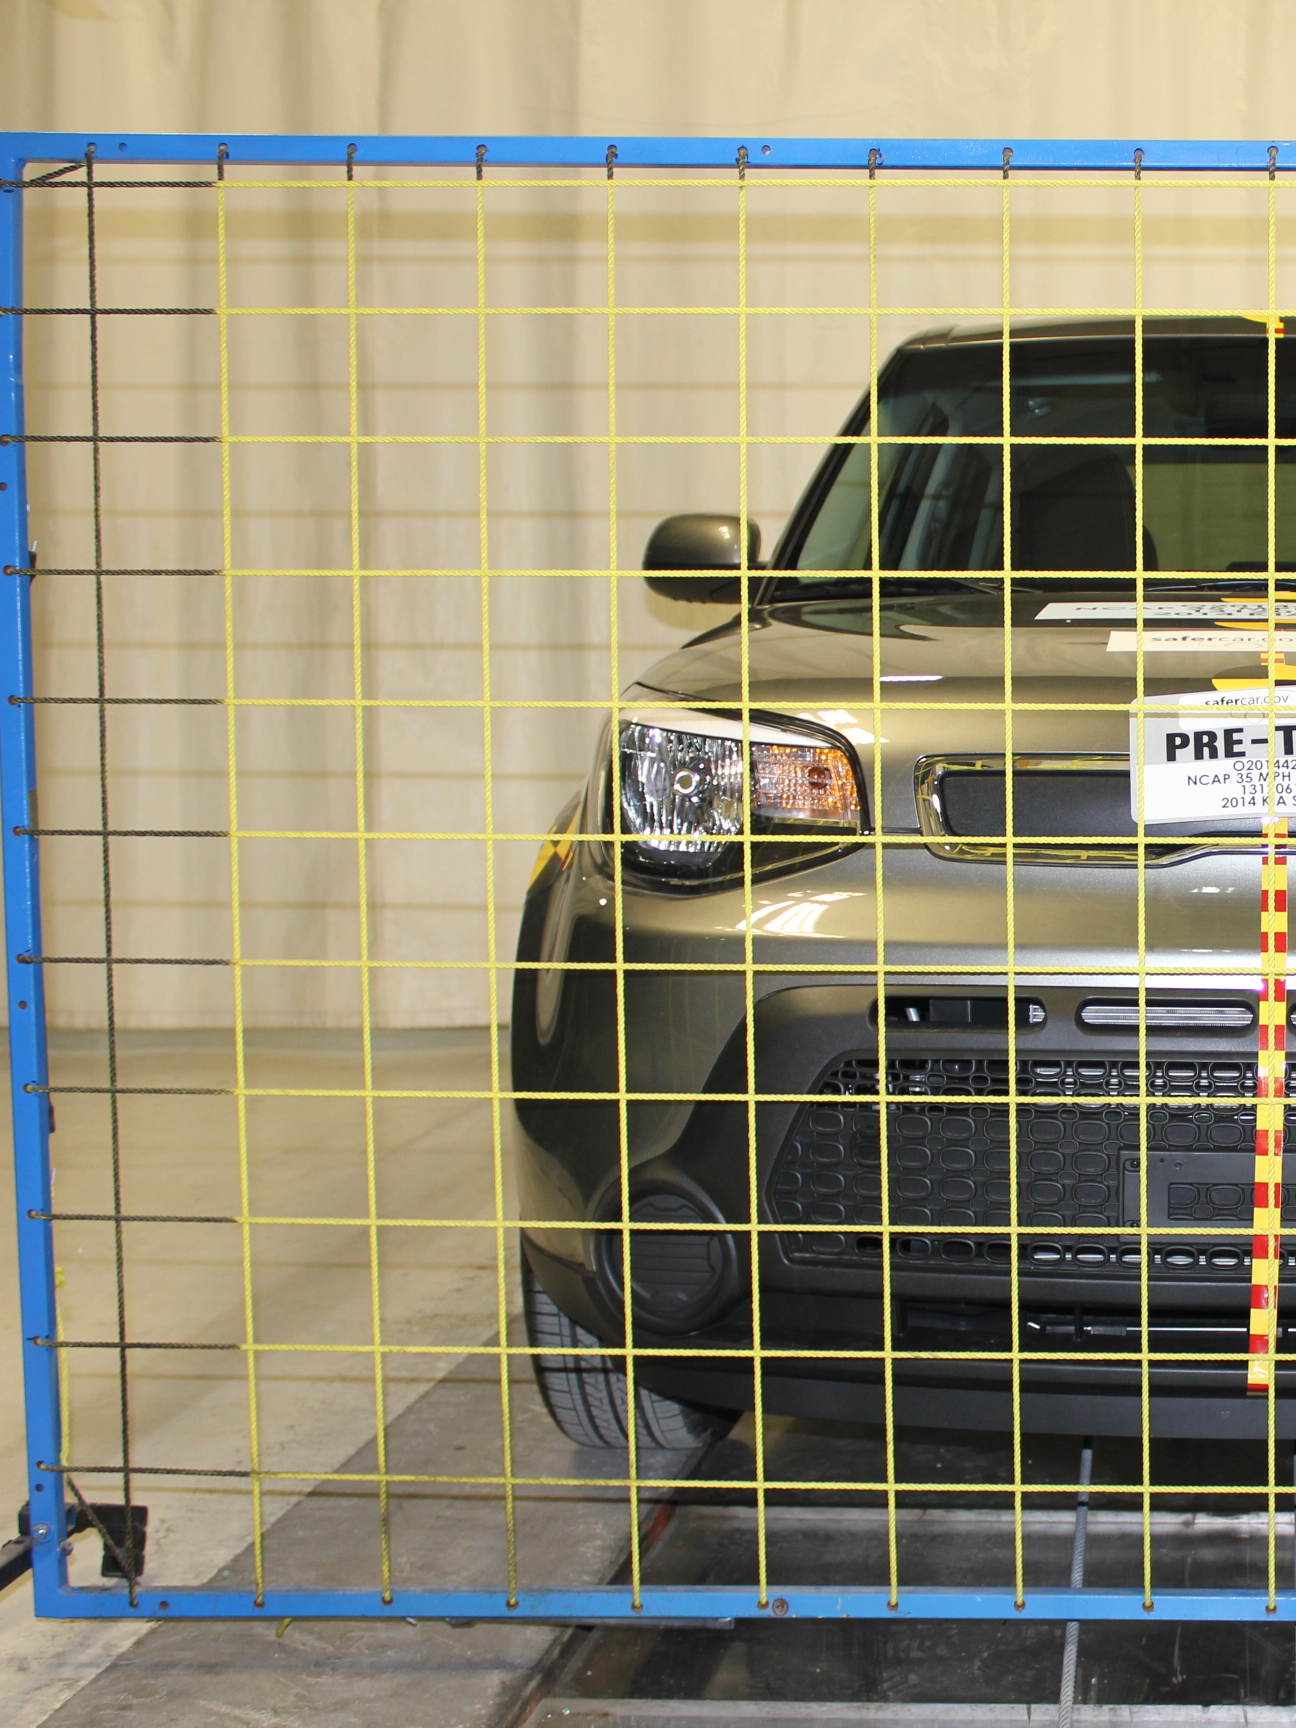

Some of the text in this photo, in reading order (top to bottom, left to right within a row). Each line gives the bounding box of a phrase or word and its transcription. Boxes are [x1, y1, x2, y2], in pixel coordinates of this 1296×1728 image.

[1187, 774, 1231, 786] NCAP
[1236, 772, 1253, 784] 35
[1258, 771, 1291, 783] MPH
[1221, 796, 1256, 808] 2014
[1262, 795, 1287, 806] KA
